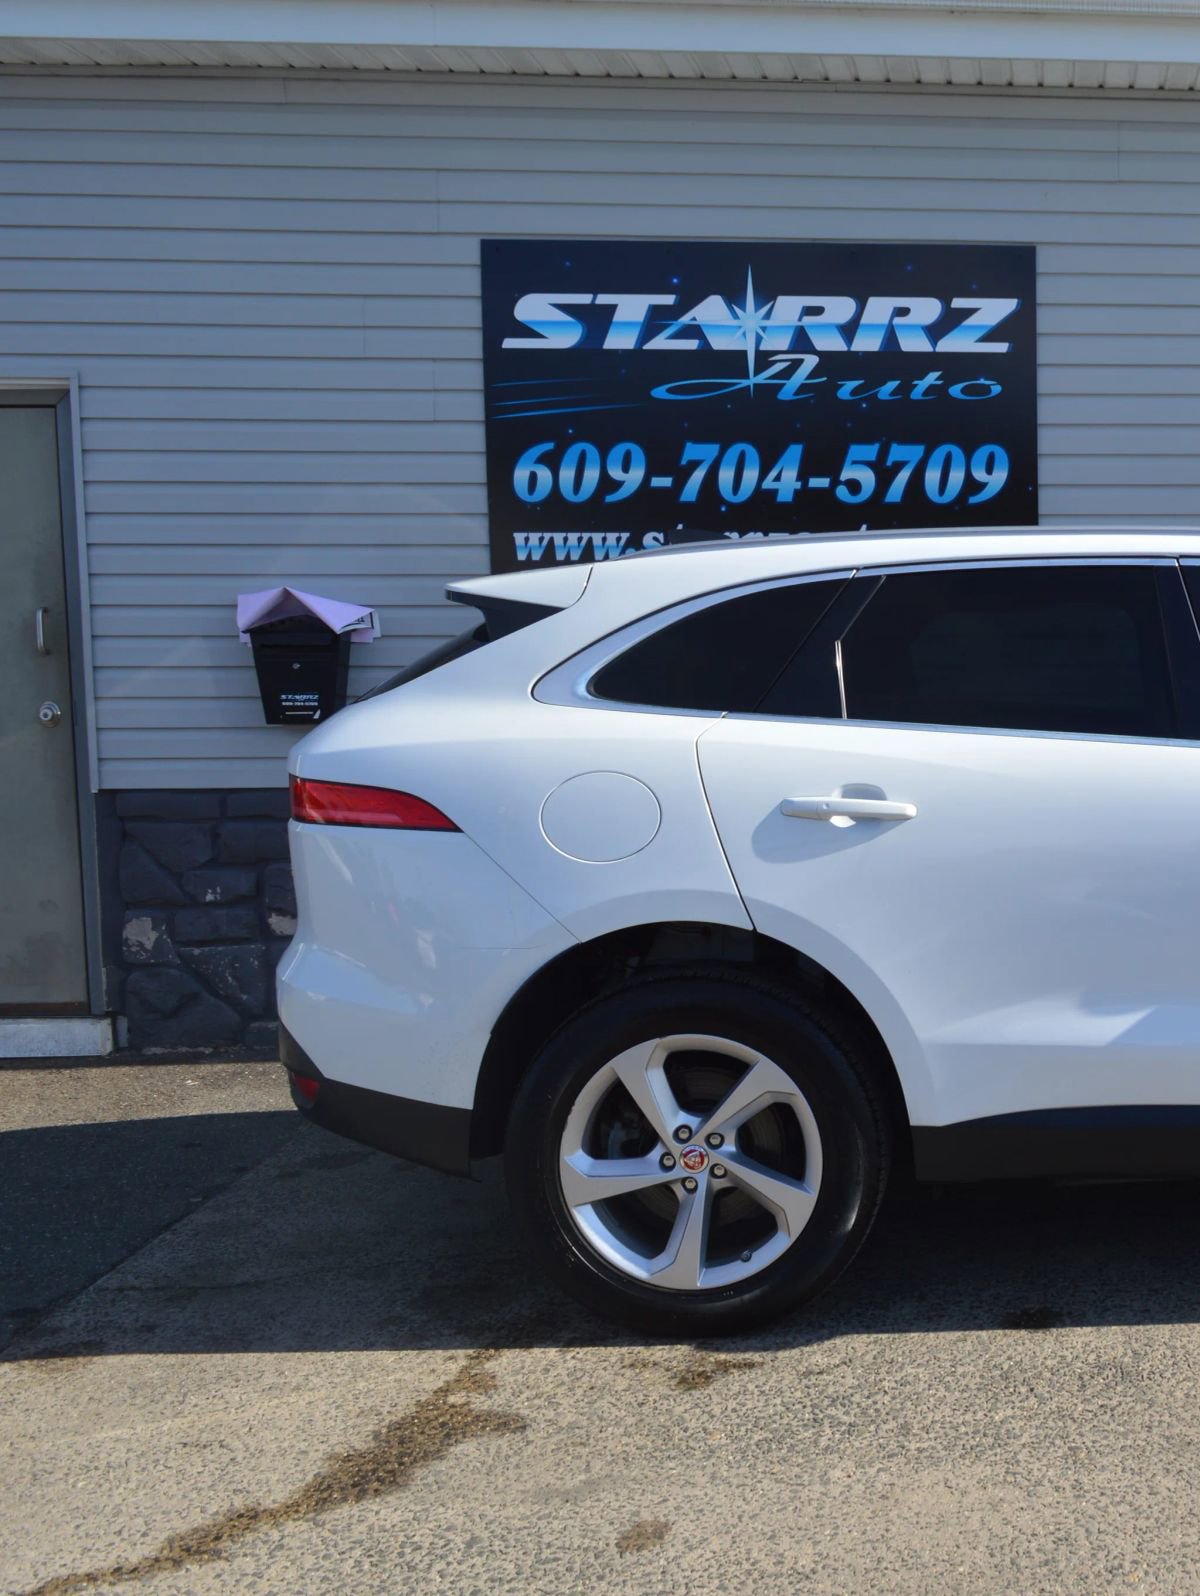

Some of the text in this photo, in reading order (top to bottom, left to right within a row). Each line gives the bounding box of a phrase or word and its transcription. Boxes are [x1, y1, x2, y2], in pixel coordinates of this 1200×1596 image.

[502, 293, 1019, 353] STARRZ
[650, 354, 1002, 400] Auto
[512, 442, 1010, 504] 609-704-5709
